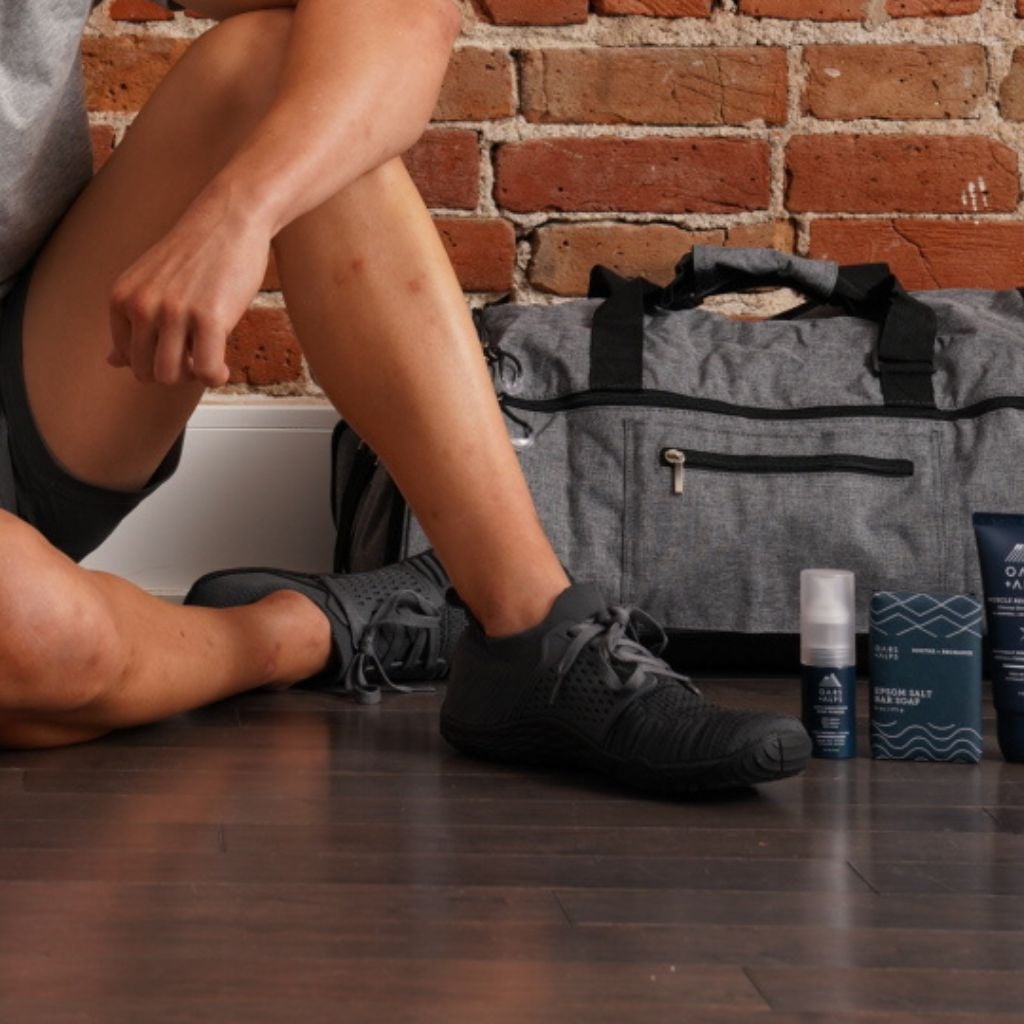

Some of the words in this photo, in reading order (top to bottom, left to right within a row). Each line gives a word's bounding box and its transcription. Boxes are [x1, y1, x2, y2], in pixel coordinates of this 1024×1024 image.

[874, 687, 906, 696] EPSOM
[909, 689, 933, 698] SALT
[895, 697, 920, 706] SOAP
